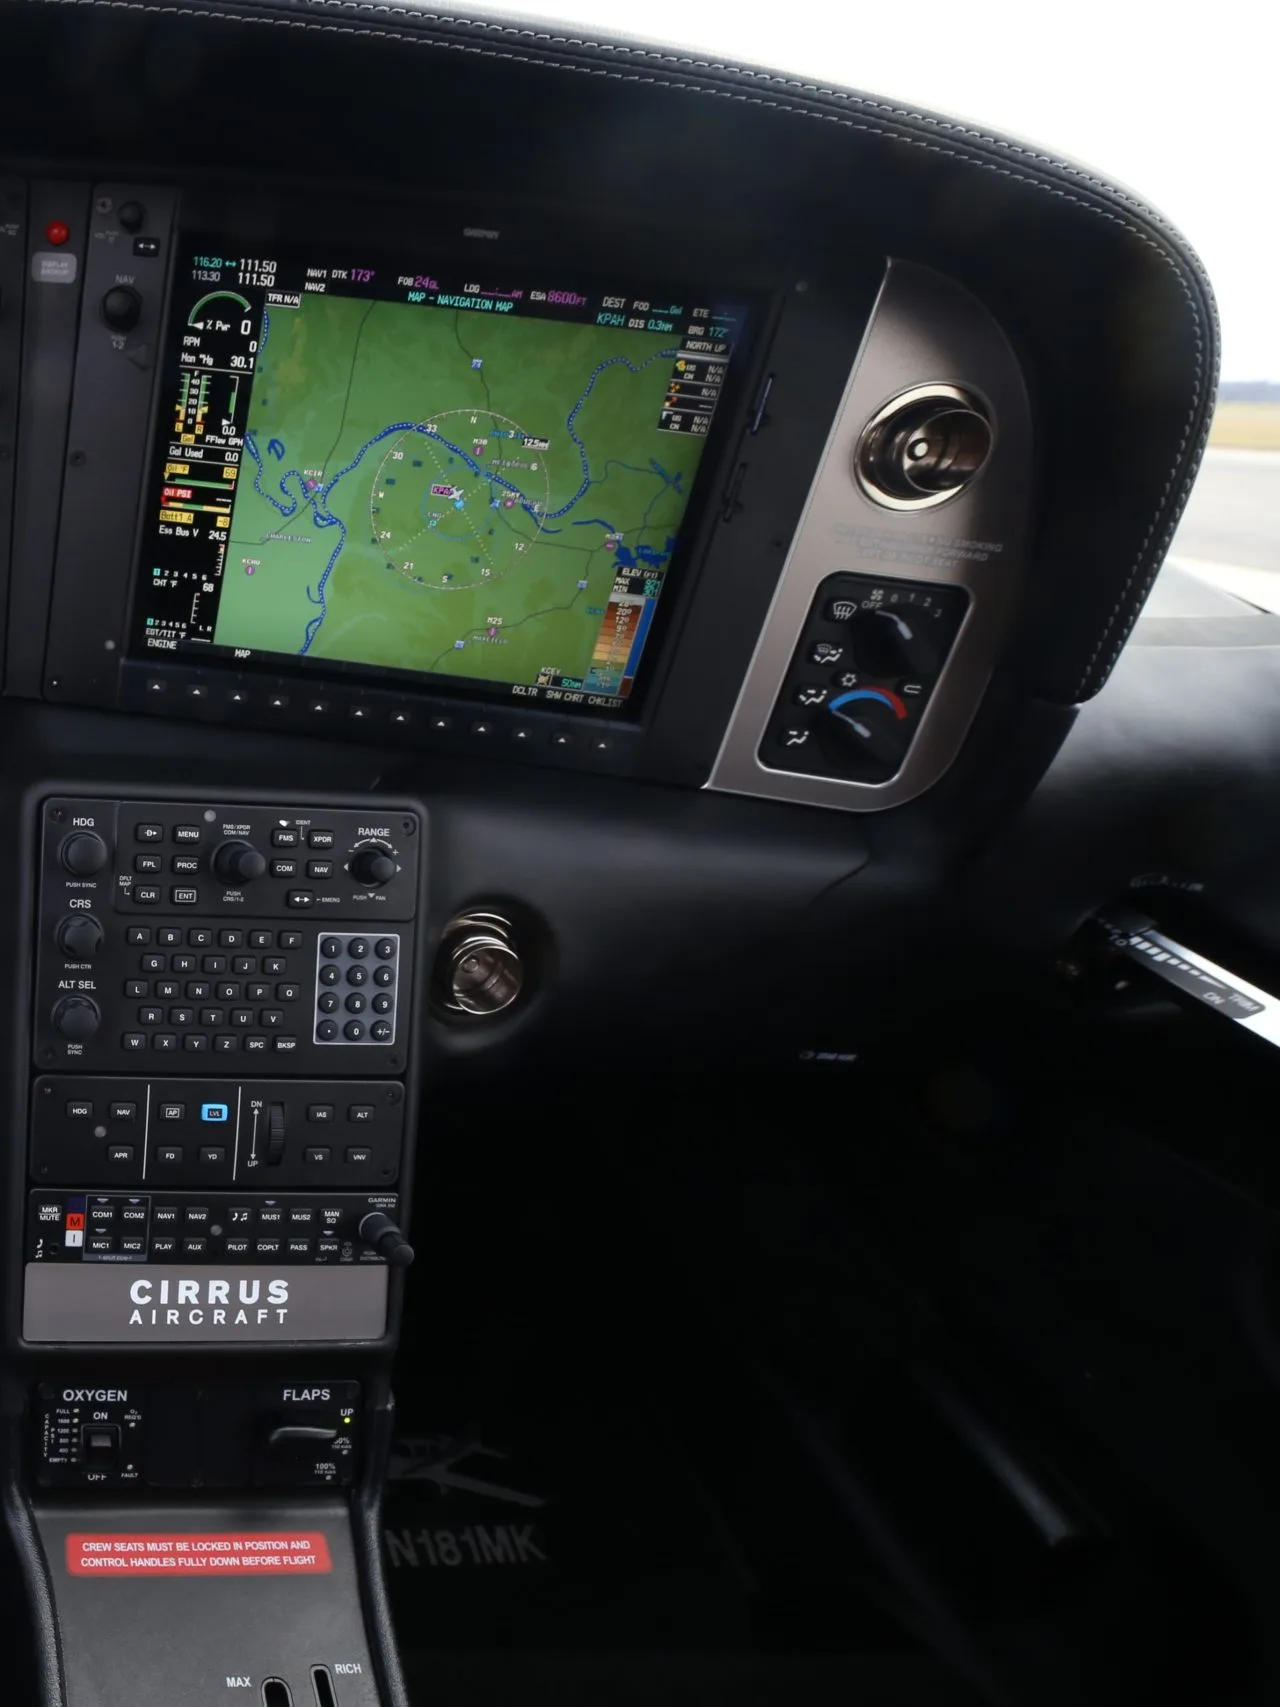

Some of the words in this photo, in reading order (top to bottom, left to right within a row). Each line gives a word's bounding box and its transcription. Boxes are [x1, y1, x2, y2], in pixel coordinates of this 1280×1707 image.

[193, 256, 222, 268] 116.20
[240, 259, 277, 273] 111.50
[192, 270, 220, 281] 113.30
[238, 273, 275, 286] 111.50
[307, 268, 326, 278] NAV1
[332, 270, 347, 279] DTK
[116, 275, 135, 284] NAV
[305, 282, 325, 292] NAV2
[531, 291, 546, 300] ESA
[408, 292, 425, 302] MAP
[438, 295, 492, 310] NAVIGATION
[496, 302, 513, 312] MAP
[603, 297, 626, 308] DEST
[693, 308, 709, 317] ETE
[597, 313, 624, 325] KPAH
[629, 318, 645, 328] DIS
[183, 336, 200, 346] RPM
[686, 341, 713, 351] NORTH
[715, 344, 726, 352] UP
[159, 525, 172, 534] Ess
[176, 527, 189, 536] Bus
[209, 531, 227, 540] 24.5
[148, 639, 177, 649] ENGINE
[235, 649, 250, 658] MAP
[512, 685, 537, 696] DCLTR
[588, 697, 622, 708] CHKLIST
[73, 818, 94, 826] HDG
[358, 828, 390, 836] RANGE
[70, 900, 91, 908] CRS
[78, 981, 96, 989] SEL
[130, 1280, 288, 1304] CIRRUS
[129, 1310, 288, 1324] AIRCRAFT
[63, 1390, 127, 1401] OXYGEN
[283, 1389, 330, 1400] FLAPS
[83, 1543, 111, 1552] CREW
[114, 1542, 144, 1551] SEATS
[147, 1542, 174, 1551] MUST
[176, 1542, 189, 1551] BE
[192, 1542, 230, 1551] LOCKED
[234, 1542, 242, 1550] IN
[245, 1541, 287, 1550] POSITION
[290, 1541, 310, 1550] AND
[385, 1524, 546, 1567] N181MK
[81, 1557, 128, 1567] CONTROL
[131, 1557, 175, 1566] HANDLES
[179, 1557, 206, 1566] FULLY
[210, 1557, 240, 1566] DOWN
[242, 1556, 281, 1565] BEFORE
[283, 1555, 315, 1565] FLIGHT
[335, 1664, 361, 1674] RICH
[226, 1677, 252, 1687] MAX
